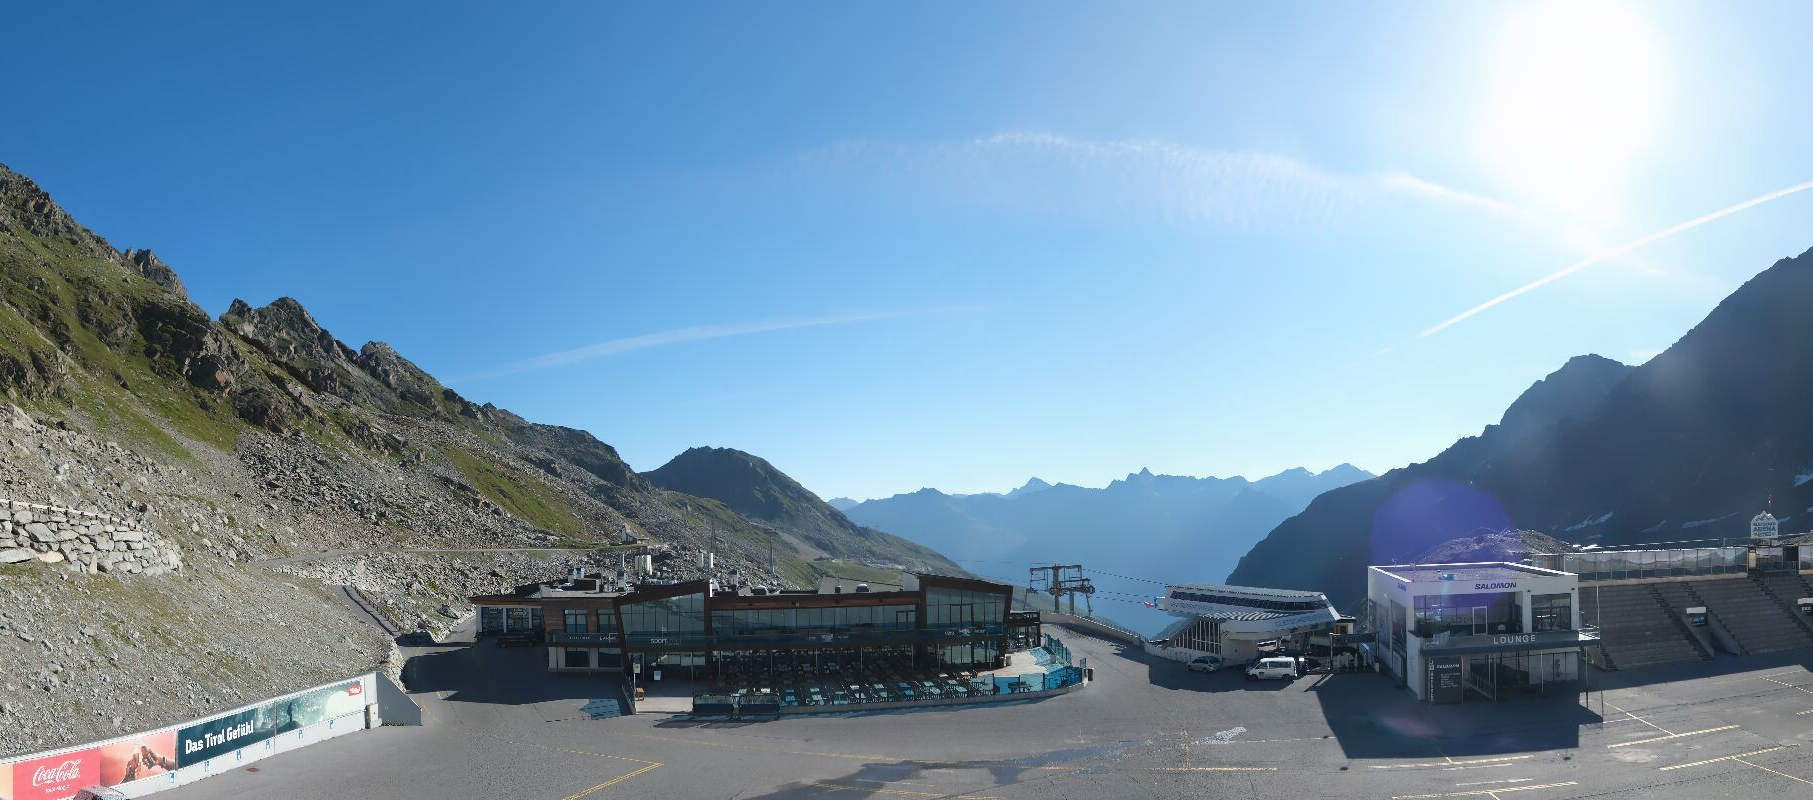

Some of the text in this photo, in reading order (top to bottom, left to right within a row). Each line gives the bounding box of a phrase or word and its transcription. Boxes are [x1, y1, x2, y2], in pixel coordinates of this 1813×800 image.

[1474, 582, 1517, 590] SALOMON
[1493, 634, 1536, 644] LOUNGE
[185, 719, 254, 755] Das Tirol Gefühl
